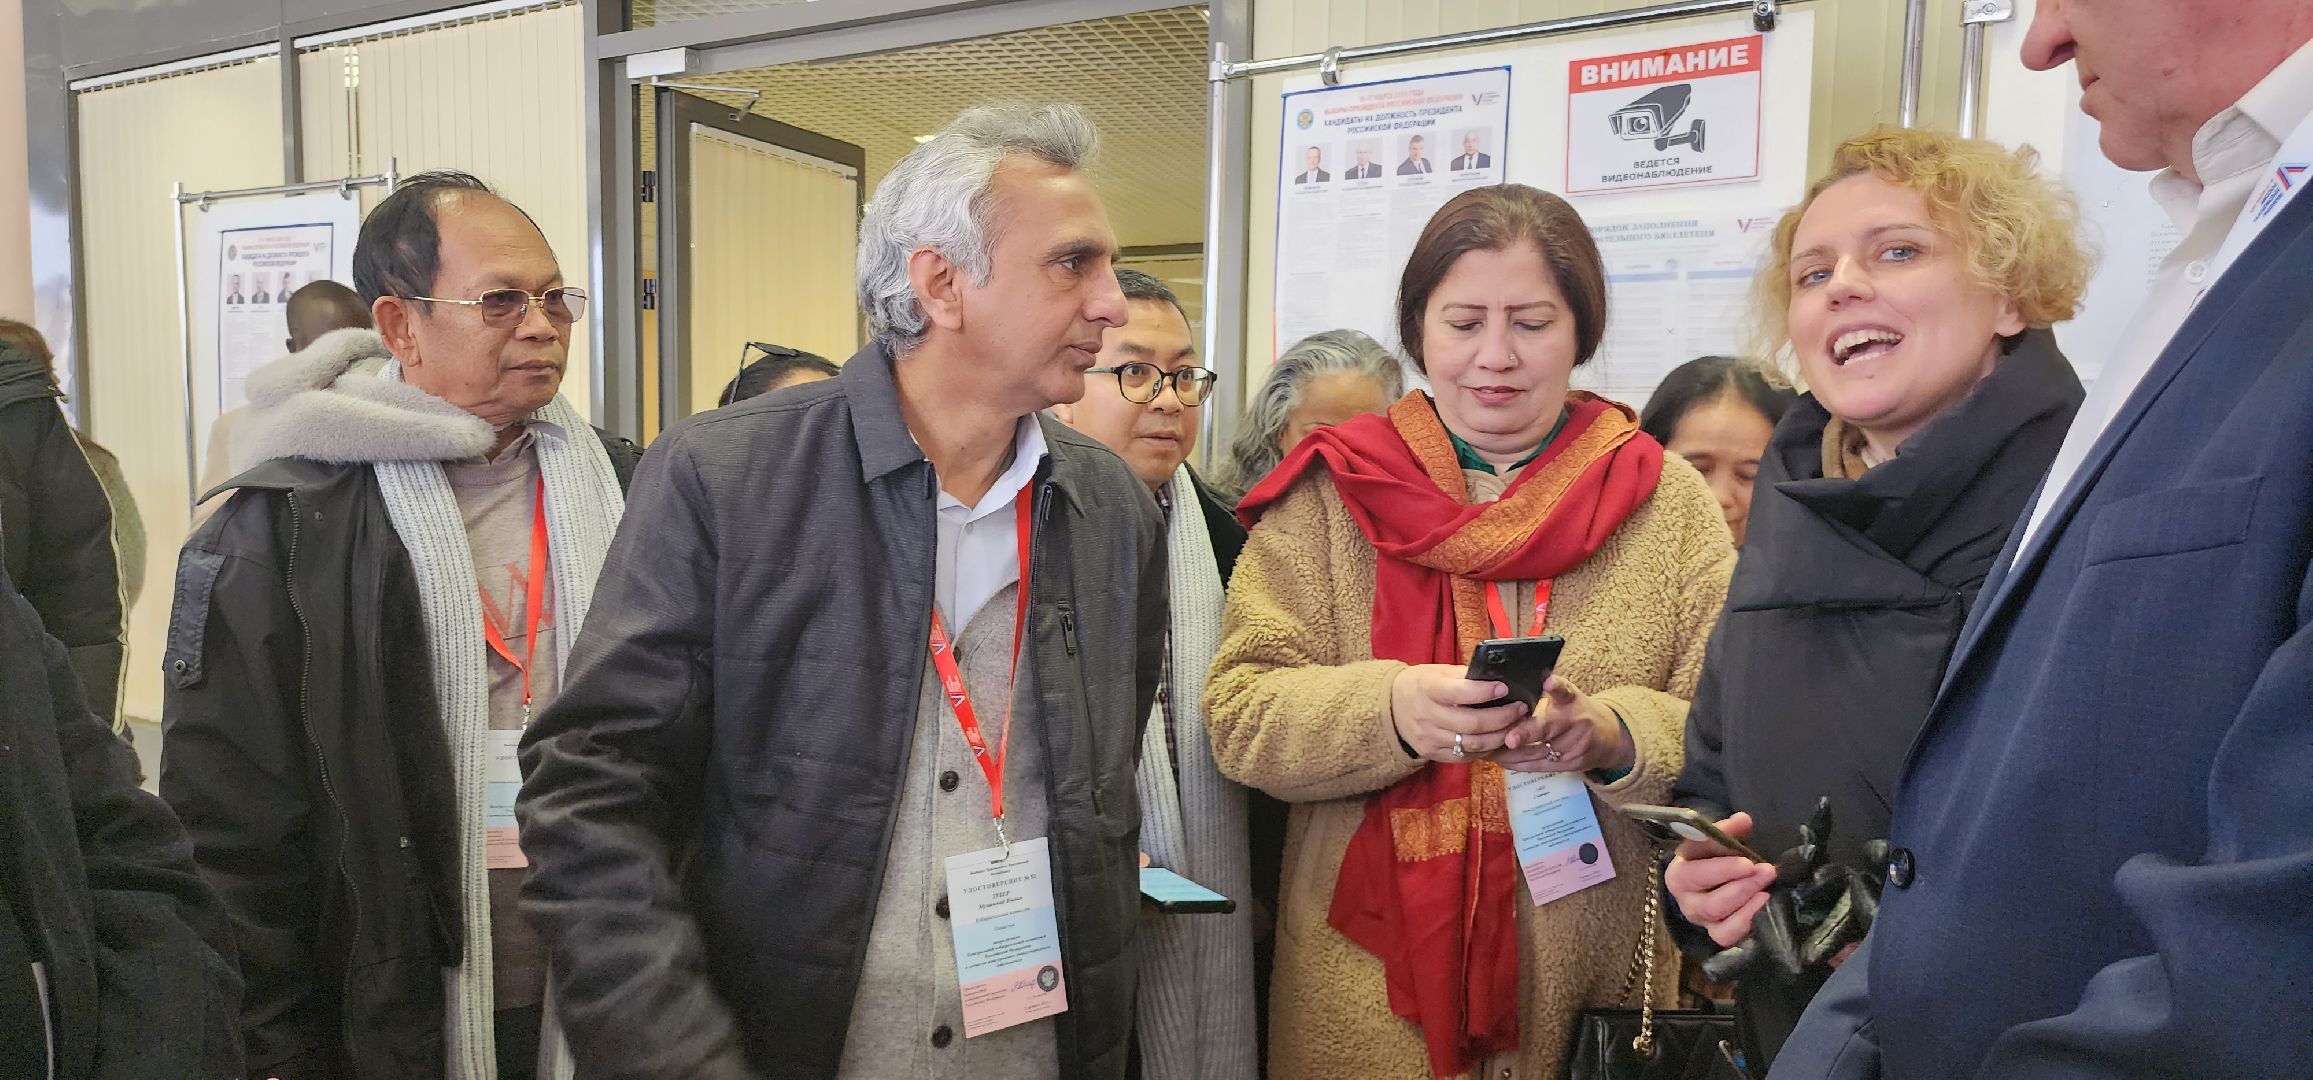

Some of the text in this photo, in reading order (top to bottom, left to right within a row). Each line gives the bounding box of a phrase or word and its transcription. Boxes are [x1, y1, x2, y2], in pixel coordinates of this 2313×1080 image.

[1581, 44, 1749, 86] ВНИМАНИЕ
[1633, 157, 1680, 169] ВЕДЕТСЯ
[1601, 165, 1713, 183] ВИДЕОНАБЛЮДЕНИЕ
